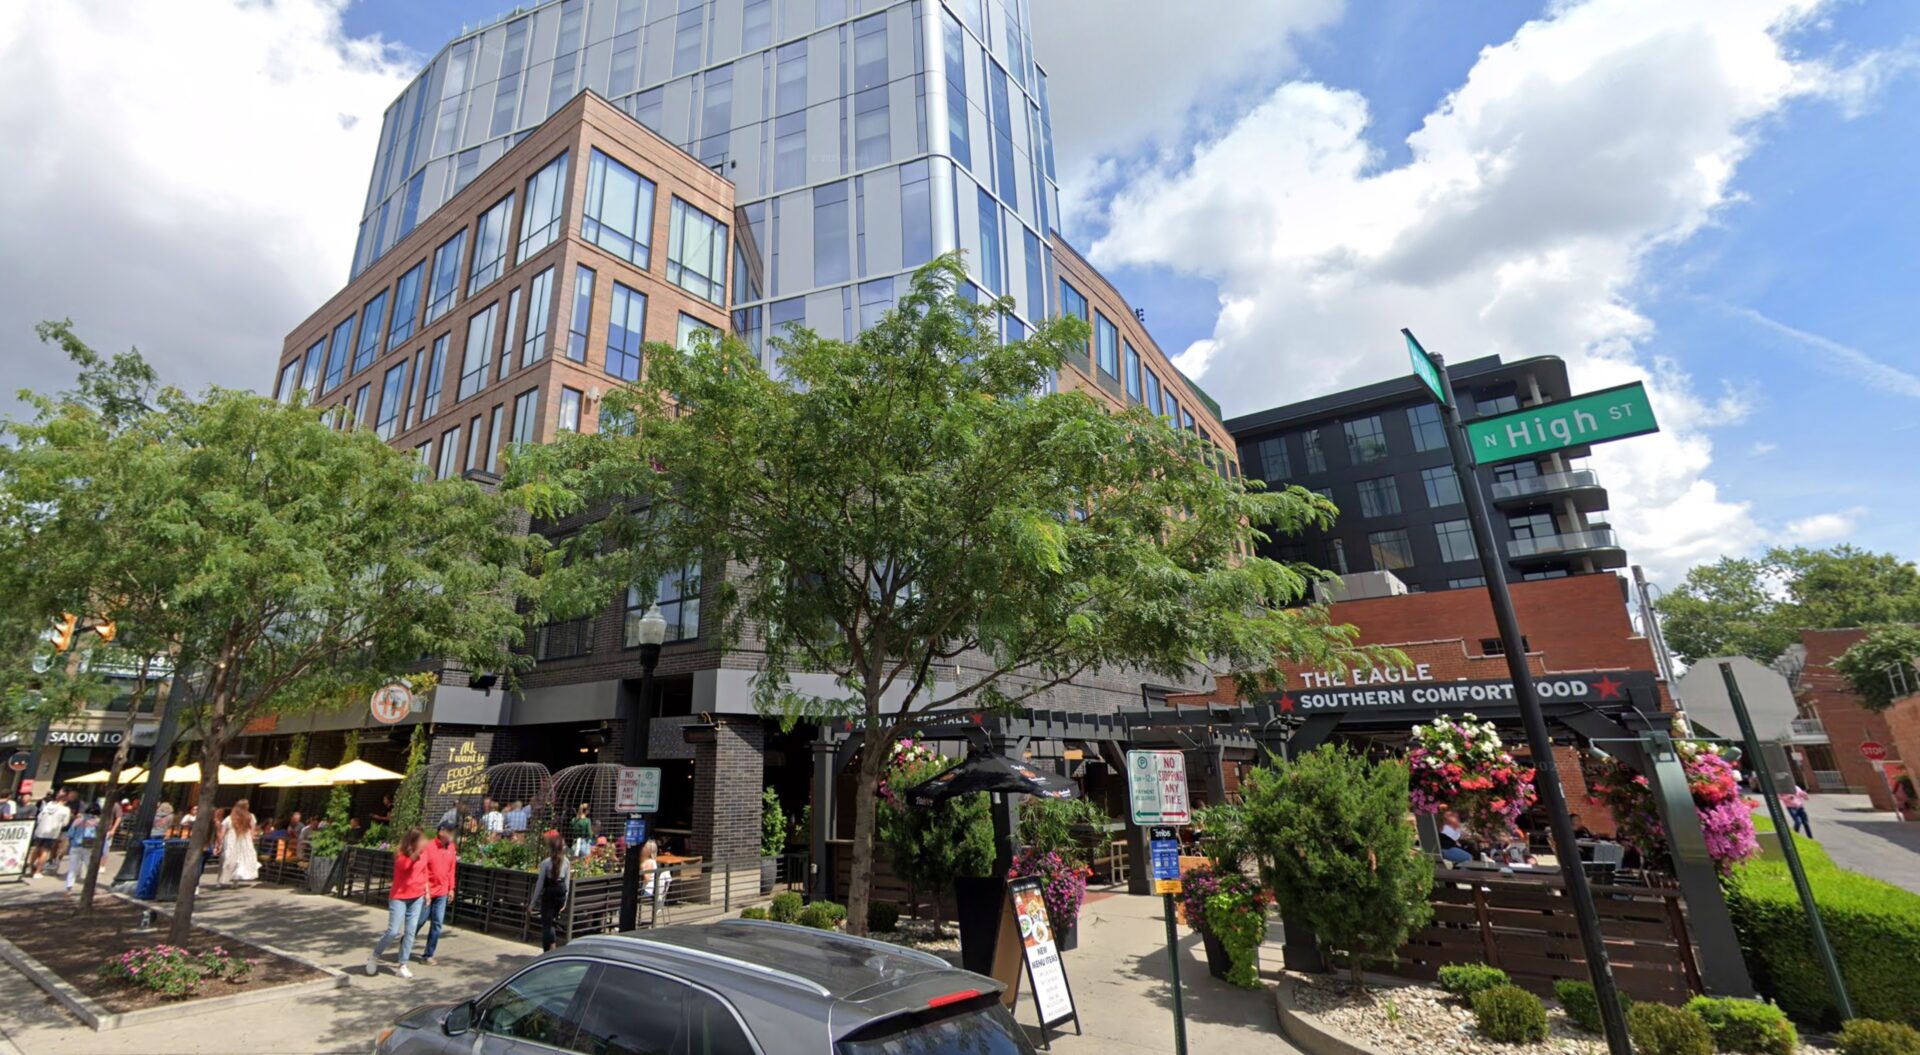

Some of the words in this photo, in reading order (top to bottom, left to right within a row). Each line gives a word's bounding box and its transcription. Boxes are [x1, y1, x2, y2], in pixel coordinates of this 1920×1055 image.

[1484, 433, 1498, 448] N
[1505, 409, 1598, 449] High
[1608, 403, 1633, 420] ST
[1300, 671, 1346, 689] THE
[1352, 663, 1433, 686] EAGLE
[1300, 689, 1406, 709] SOUTHERN
[1412, 683, 1515, 704] COMFORT
[1532, 680, 1588, 698] OOD
[855, 717, 883, 730] FOD
[48, 732, 99, 743] SALON
[1861, 745, 1886, 755] STOP
[1163, 757, 1175, 768] NO
[447, 765, 472, 780] FOOD
[1158, 770, 1184, 781] STOPPING
[1164, 783, 1179, 793] ANY
[1165, 794, 1182, 805] TIME
[1037, 946, 1047, 955] NEW
